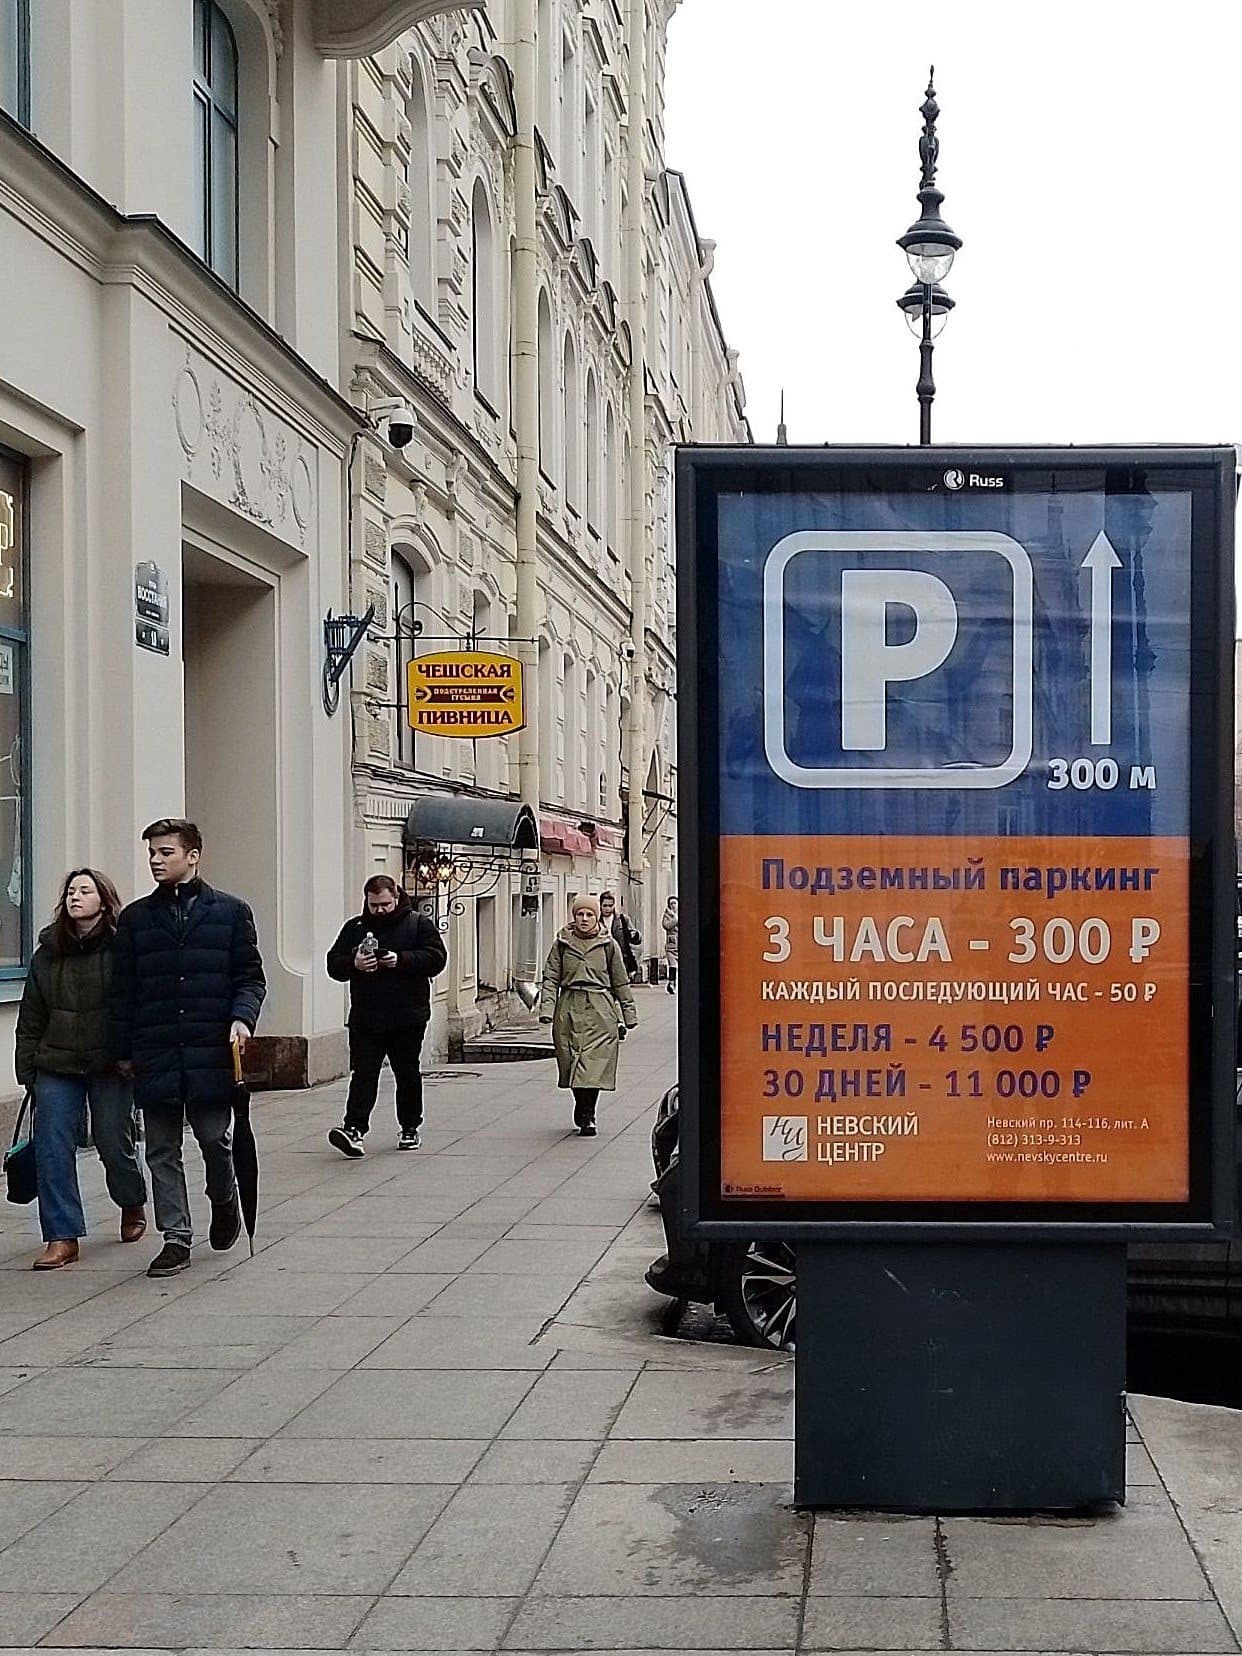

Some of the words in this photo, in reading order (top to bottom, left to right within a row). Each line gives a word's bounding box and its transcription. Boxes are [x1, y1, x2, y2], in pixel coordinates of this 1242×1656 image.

[969, 474, 1003, 487] Russ
[417, 664, 511, 678] ЧЕШСКАЯ
[842, 569, 957, 750] P
[418, 711, 512, 724] ПИВНИЦА
[1047, 758, 1118, 789] 300
[1130, 766, 1156, 789] м
[762, 857, 985, 895] Подземный
[1000, 867, 1160, 898] паркинг
[763, 916, 791, 963] 3
[813, 916, 952, 963] ЧАСА
[1008, 917, 1111, 963] 300
[762, 978, 860, 1004] КАЖДЫЙ
[869, 979, 1040, 1004] ПОСЛЕДУЮЩИЙ
[1047, 982, 1088, 1001] ЧАС
[1110, 983, 1137, 1001] 50
[762, 1024, 890, 1057] НЕДЕЛЯ
[928, 1025, 948, 1051] 4
[961, 1025, 1024, 1051] 500
[763, 1069, 804, 1097] 30
[815, 1063, 905, 1102] ДНЕЙ
[946, 1070, 983, 1097] 11
[997, 1070, 1060, 1097] 000
[817, 1112, 918, 1135] НЕВСКИЙ
[987, 1117, 1036, 1128] Невский
[1040, 1119, 1057, 1130] пр.
[1062, 1118, 1111, 1130] 114-116,
[1114, 1120, 1137, 1129] лит.
[1140, 1119, 1149, 1129] А
[987, 1134, 1018, 1147] (812)
[1022, 1134, 1081, 1146] 313-9-313
[817, 1142, 884, 1165] ЦЕНТР
[986, 1151, 1108, 1164] www.nevskycentre.ru
